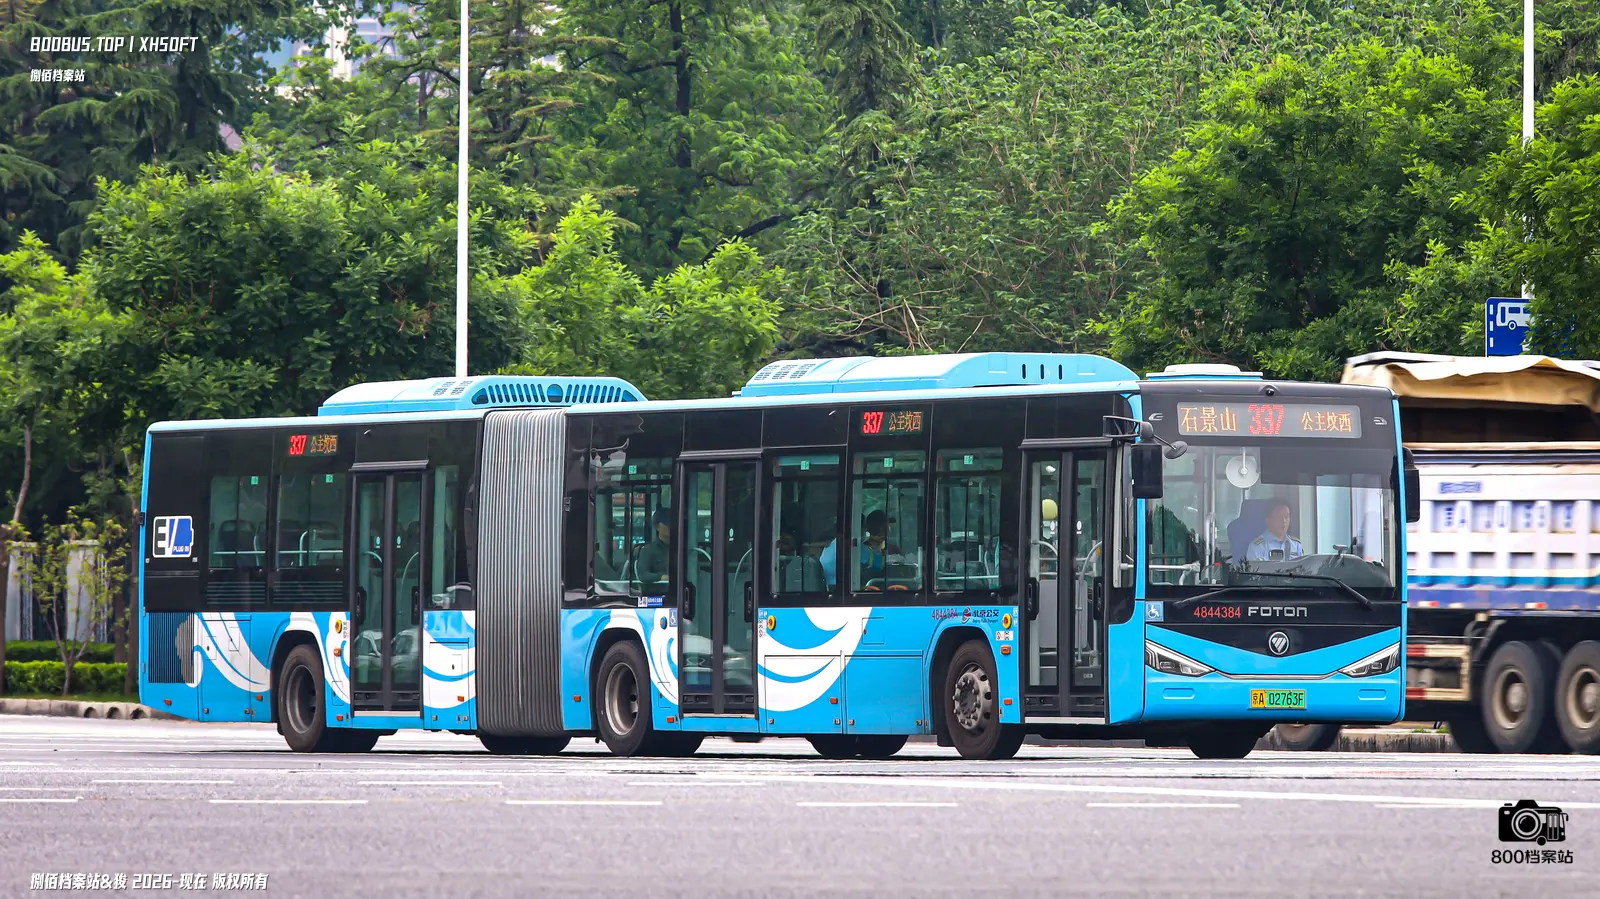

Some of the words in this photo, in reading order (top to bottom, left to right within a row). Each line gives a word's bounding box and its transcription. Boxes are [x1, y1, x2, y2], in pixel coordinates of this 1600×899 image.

[863, 411, 884, 434] 337
[888, 411, 922, 432] 公主坟西
[1180, 407, 1238, 432] 石景山
[1248, 405, 1285, 435] 337
[1301, 411, 1353, 432] 公主坟西
[289, 434, 308, 455] 337
[973, 609, 1000, 618] 北京公交
[1193, 606, 1241, 618] 4844384
[1248, 606, 1308, 618] FOTON
[1268, 692, 1304, 706] 02763F
